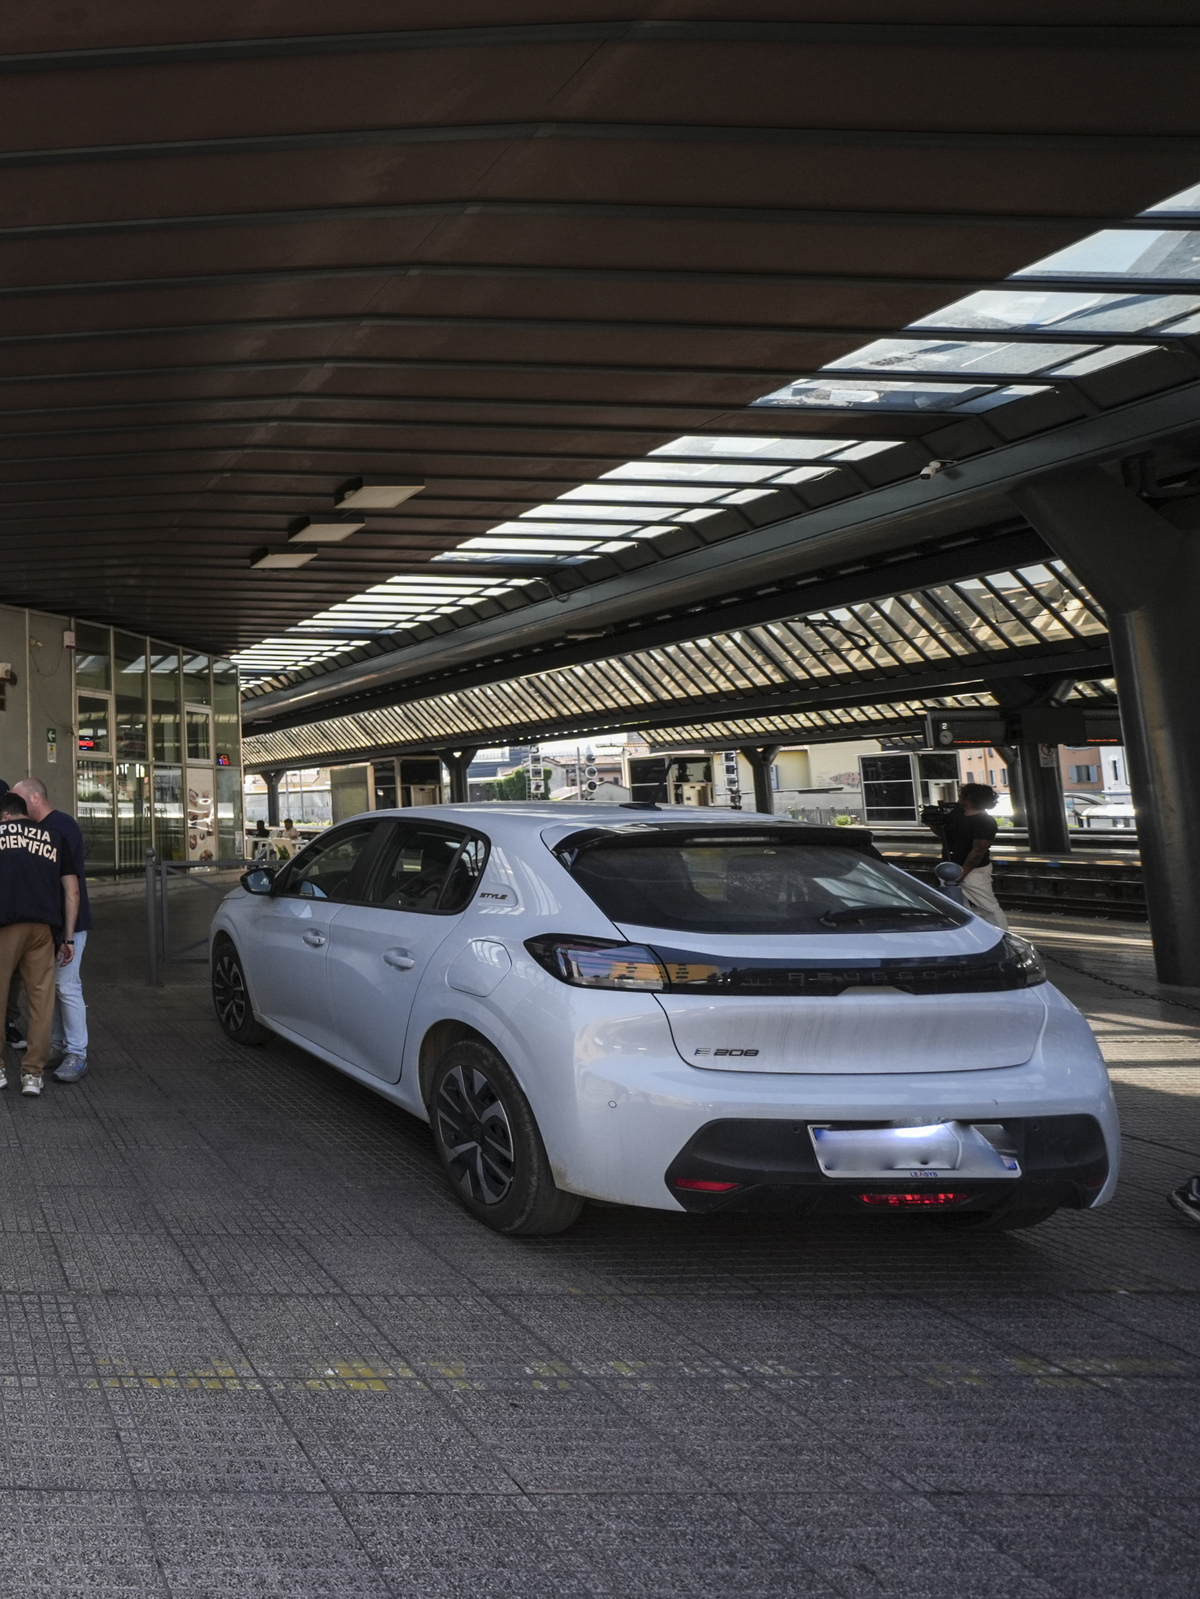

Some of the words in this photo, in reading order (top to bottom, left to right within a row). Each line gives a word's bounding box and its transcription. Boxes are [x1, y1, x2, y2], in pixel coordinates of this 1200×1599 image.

[941, 722, 948, 730] 2
[0, 823, 51, 842] POLIZIA
[479, 892, 508, 900] STYLE
[713, 1048, 759, 1057] 208
